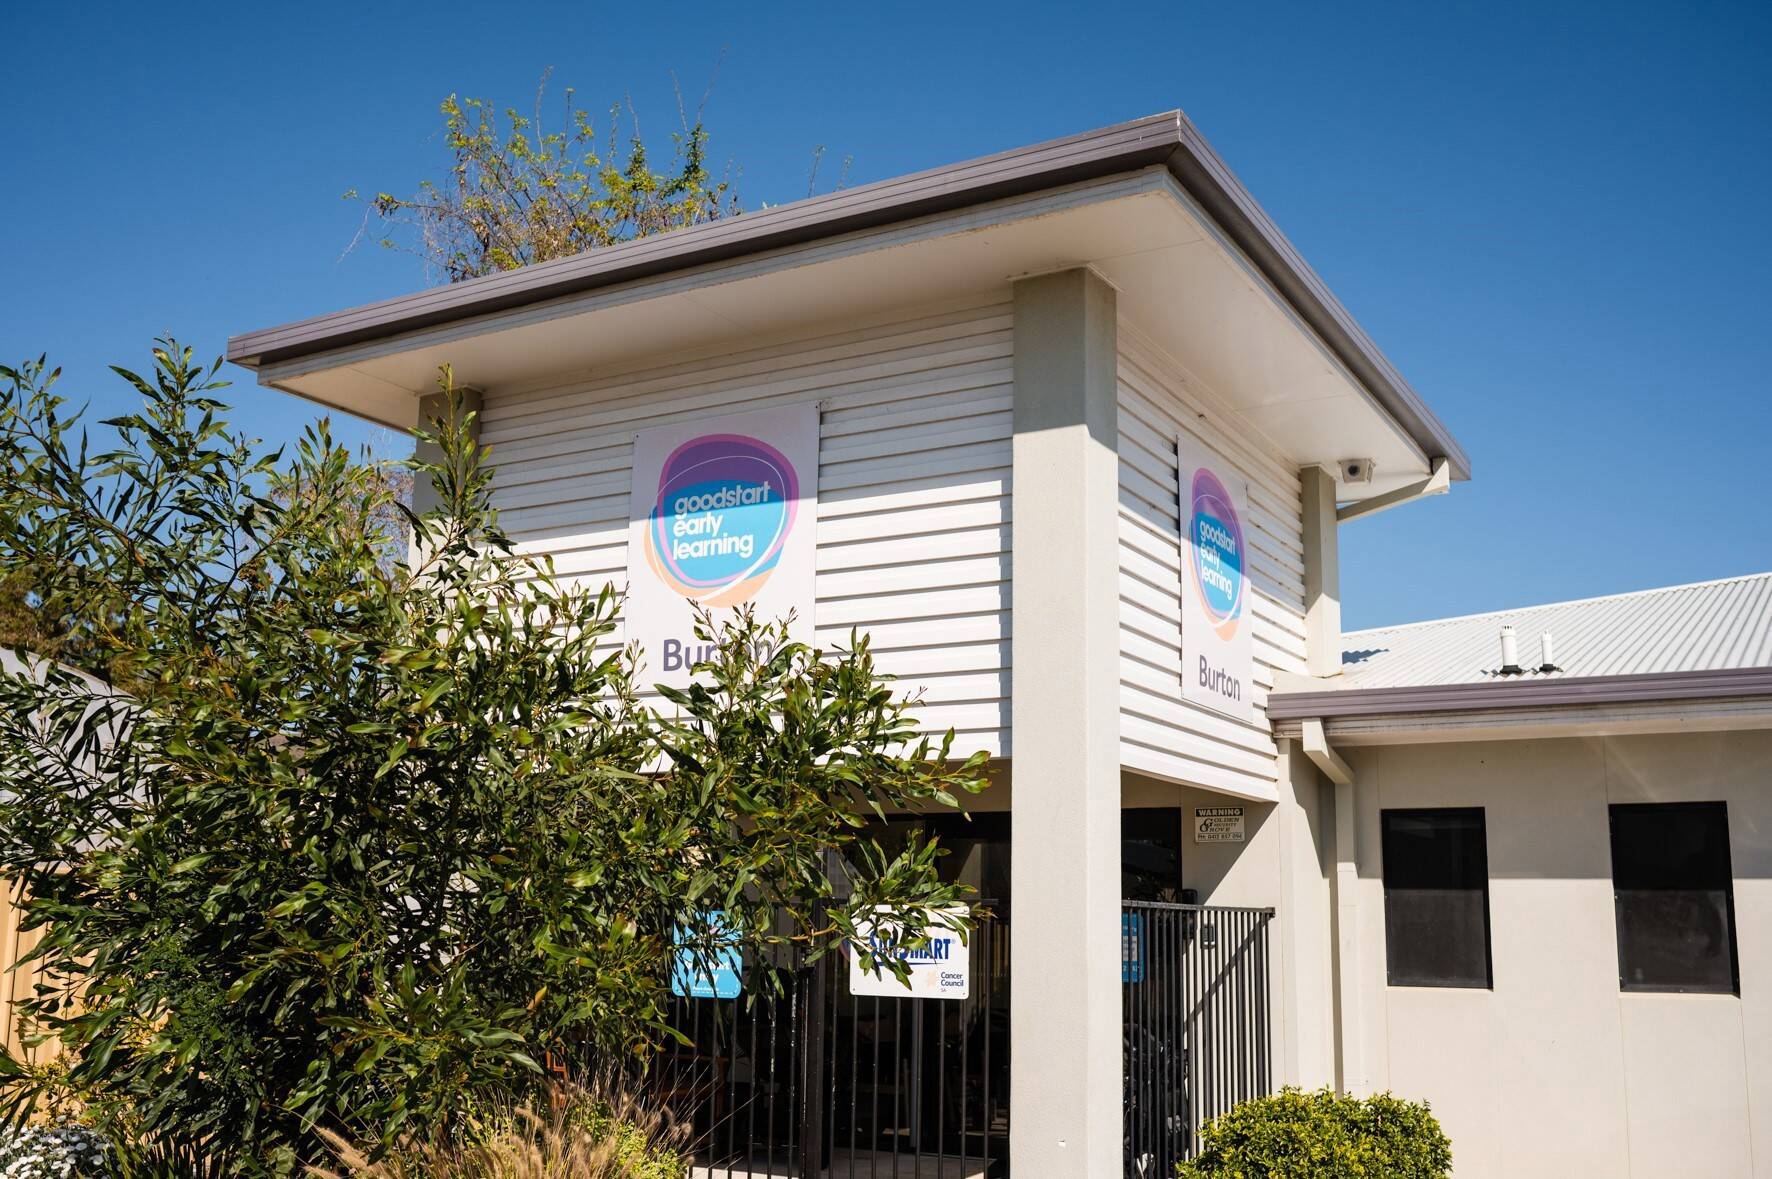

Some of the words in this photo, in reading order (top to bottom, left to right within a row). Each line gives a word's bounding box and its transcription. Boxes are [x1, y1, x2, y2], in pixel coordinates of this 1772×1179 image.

[674, 480, 771, 520] goodstart
[673, 511, 724, 537] early
[1200, 520, 1236, 555] goodstart
[673, 533, 754, 560] learning
[1200, 542, 1220, 570] early
[1201, 559, 1232, 600] learning
[663, 638, 773, 672] Burn
[1199, 654, 1240, 702] Burton
[940, 971, 963, 979] Cancer
[940, 979, 964, 987] Council
